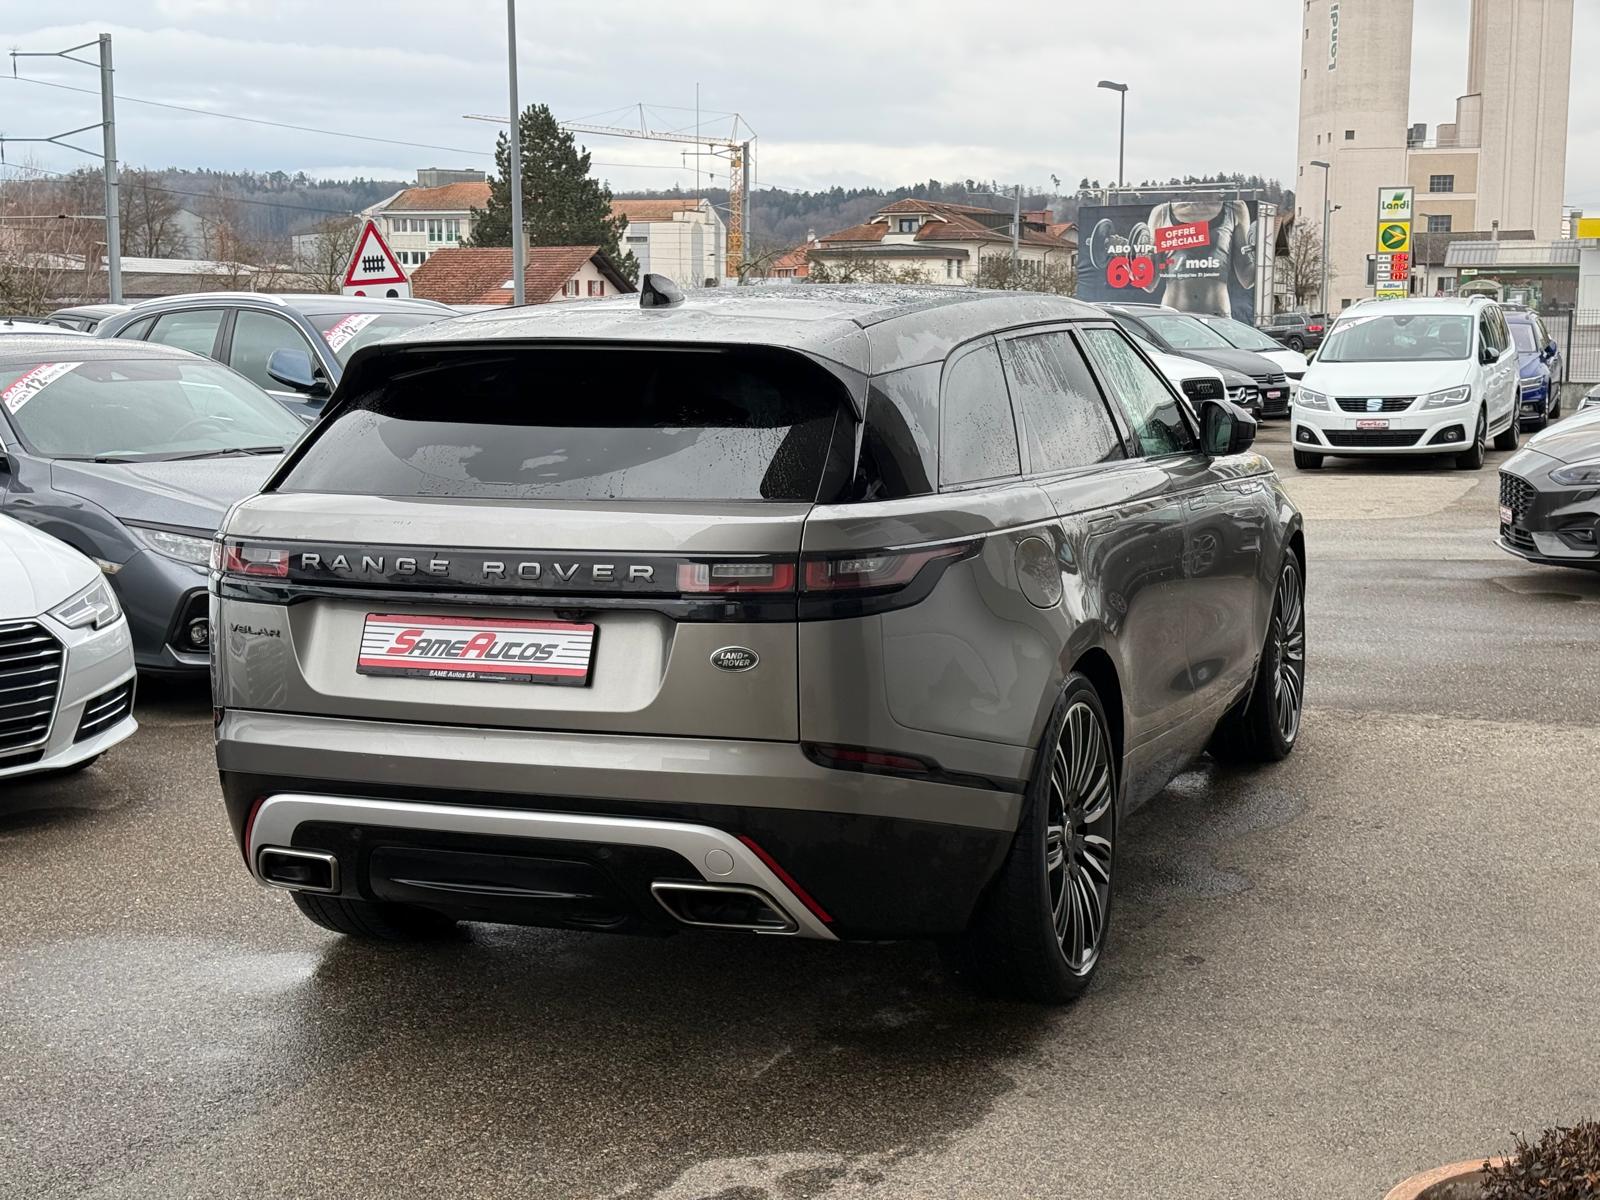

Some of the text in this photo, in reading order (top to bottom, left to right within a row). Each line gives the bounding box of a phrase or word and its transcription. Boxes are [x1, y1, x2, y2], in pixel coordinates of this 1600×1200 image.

[1328, 4, 1339, 71] Landi
[1382, 200, 1409, 210] Landi
[1165, 226, 1196, 239] OFFRE
[1160, 234, 1205, 249] SPÉCIALE
[1107, 245, 1131, 254] ABO
[1186, 256, 1220, 269] mois
[342, 326, 358, 337] 12
[26, 379, 48, 390] 12
[300, 553, 655, 583] RANGE ROVER
[720, 652, 743, 660] LAND
[722, 659, 751, 667] ROVER
